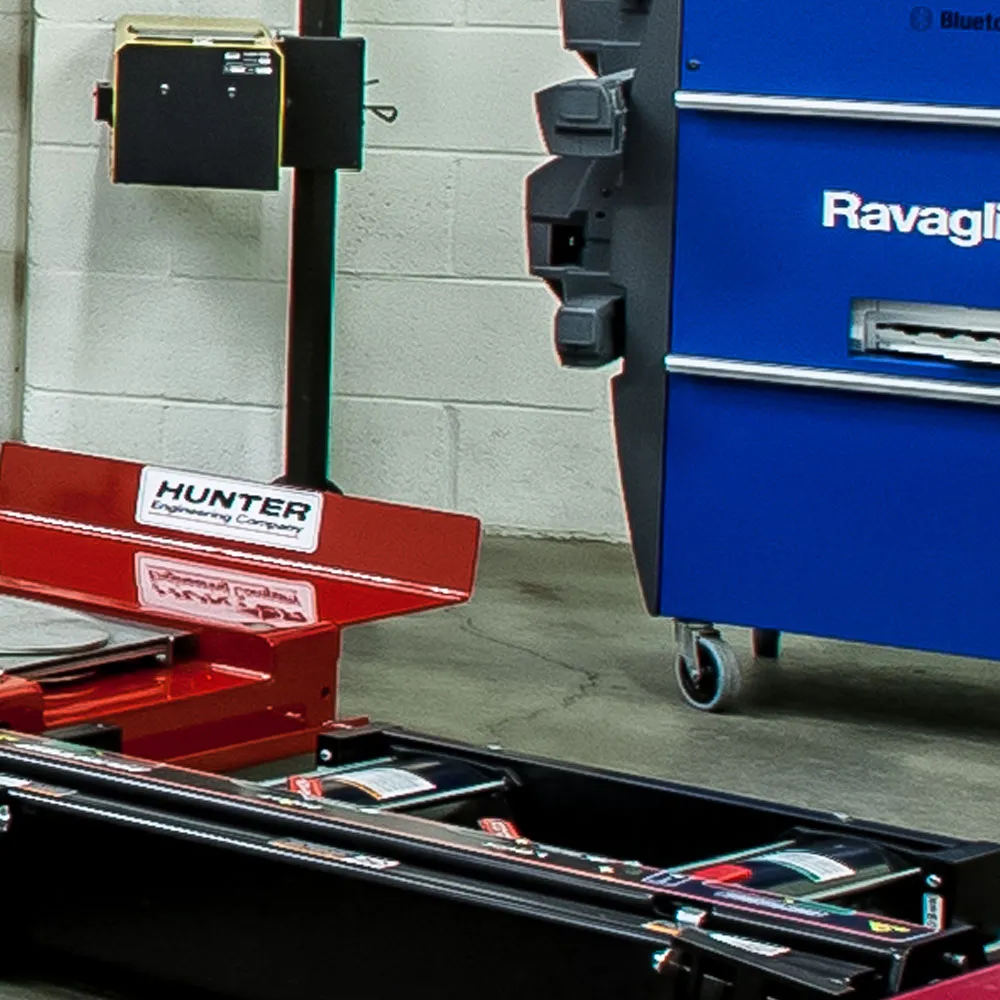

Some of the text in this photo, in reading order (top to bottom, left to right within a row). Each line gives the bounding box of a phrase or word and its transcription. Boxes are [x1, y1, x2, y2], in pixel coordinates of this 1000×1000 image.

[151, 499, 305, 534] Engineering Company
[156, 480, 312, 523] HUNTER
